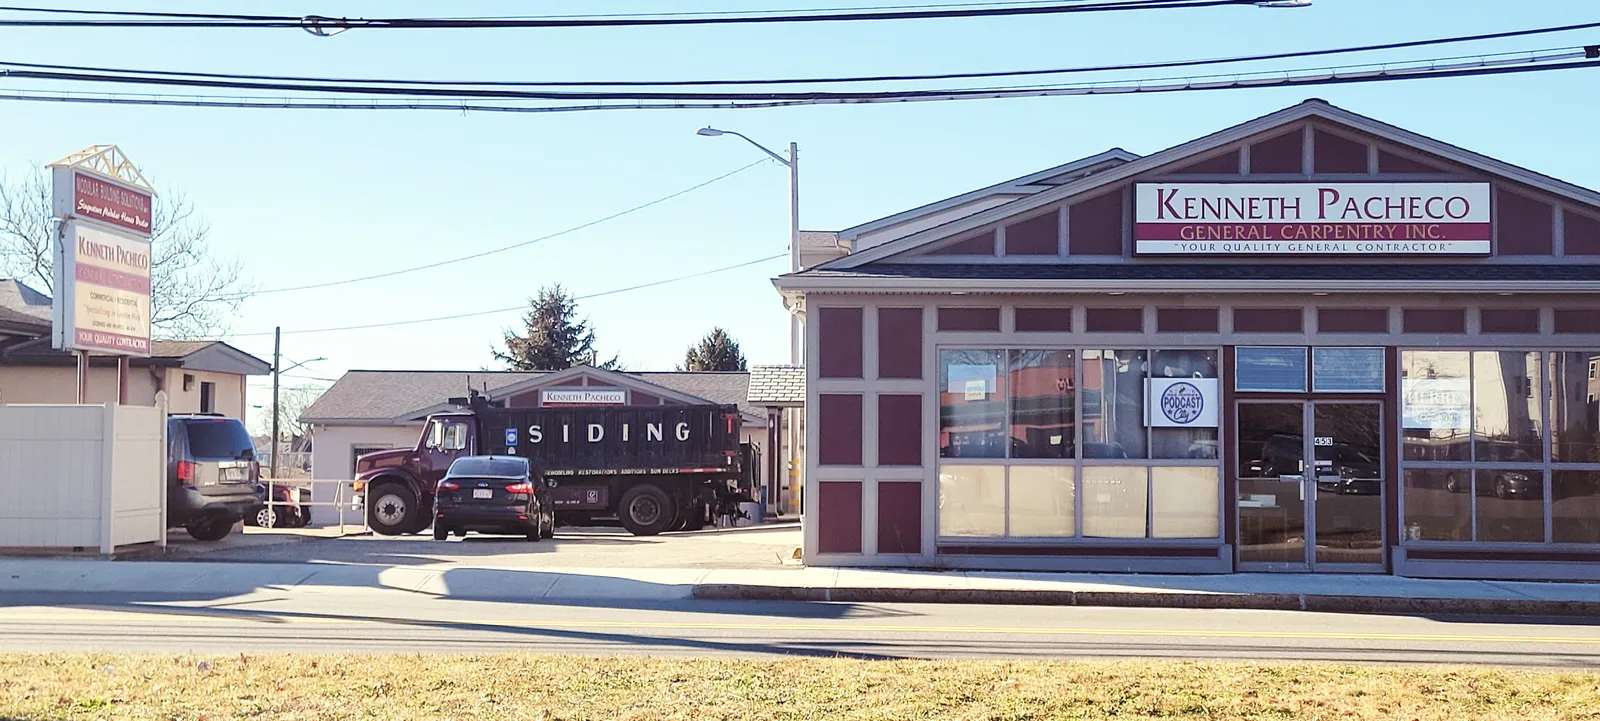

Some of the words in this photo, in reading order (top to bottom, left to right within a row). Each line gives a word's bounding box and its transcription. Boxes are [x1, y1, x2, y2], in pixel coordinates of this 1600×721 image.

[1156, 188, 1301, 220] KENNETH
[1317, 188, 1470, 220] PACHECO
[1180, 224, 1272, 240] GENERAL
[1280, 224, 1395, 240] CARPENTRY
[1405, 224, 1446, 239] INC.
[78, 235, 115, 263] KENNETH
[116, 245, 148, 270] PACHECO
[1174, 243, 1217, 251] "YOUR
[1223, 243, 1281, 252] QUALITY
[1288, 243, 1348, 252] GENERAL
[1356, 243, 1453, 252] CONTRACTOR"
[78, 331, 93, 342] YOUR
[94, 333, 115, 345] QUALITY
[116, 336, 147, 349] CONTRACTOR
[547, 392, 582, 401] KENNETH
[584, 392, 622, 401] PACHECO
[1164, 396, 1201, 409] PODCAST
[528, 422, 690, 443] SIDING
[1315, 437, 1332, 445] 453
